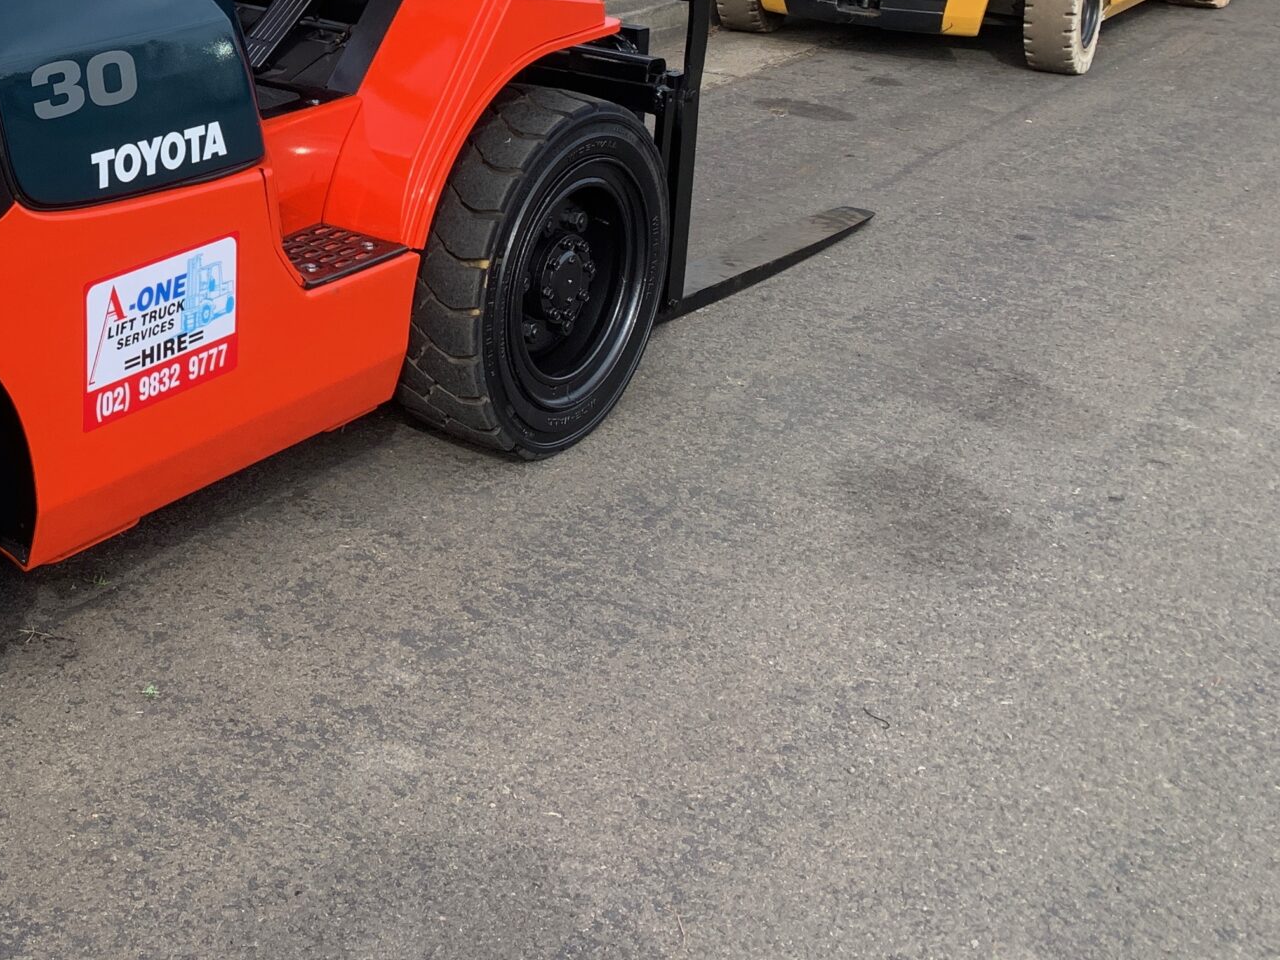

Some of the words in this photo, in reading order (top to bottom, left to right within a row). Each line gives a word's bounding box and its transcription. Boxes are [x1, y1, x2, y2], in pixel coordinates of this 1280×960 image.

[31, 50, 138, 120] 30
[91, 121, 228, 189] TOYOTA
[107, 317, 136, 340] LIFT
[141, 298, 187, 327] TRUCK
[116, 318, 175, 350] SERVICES
[96, 382, 130, 422] (02)
[139, 363, 180, 402] 9832
[188, 343, 228, 381] 9777
